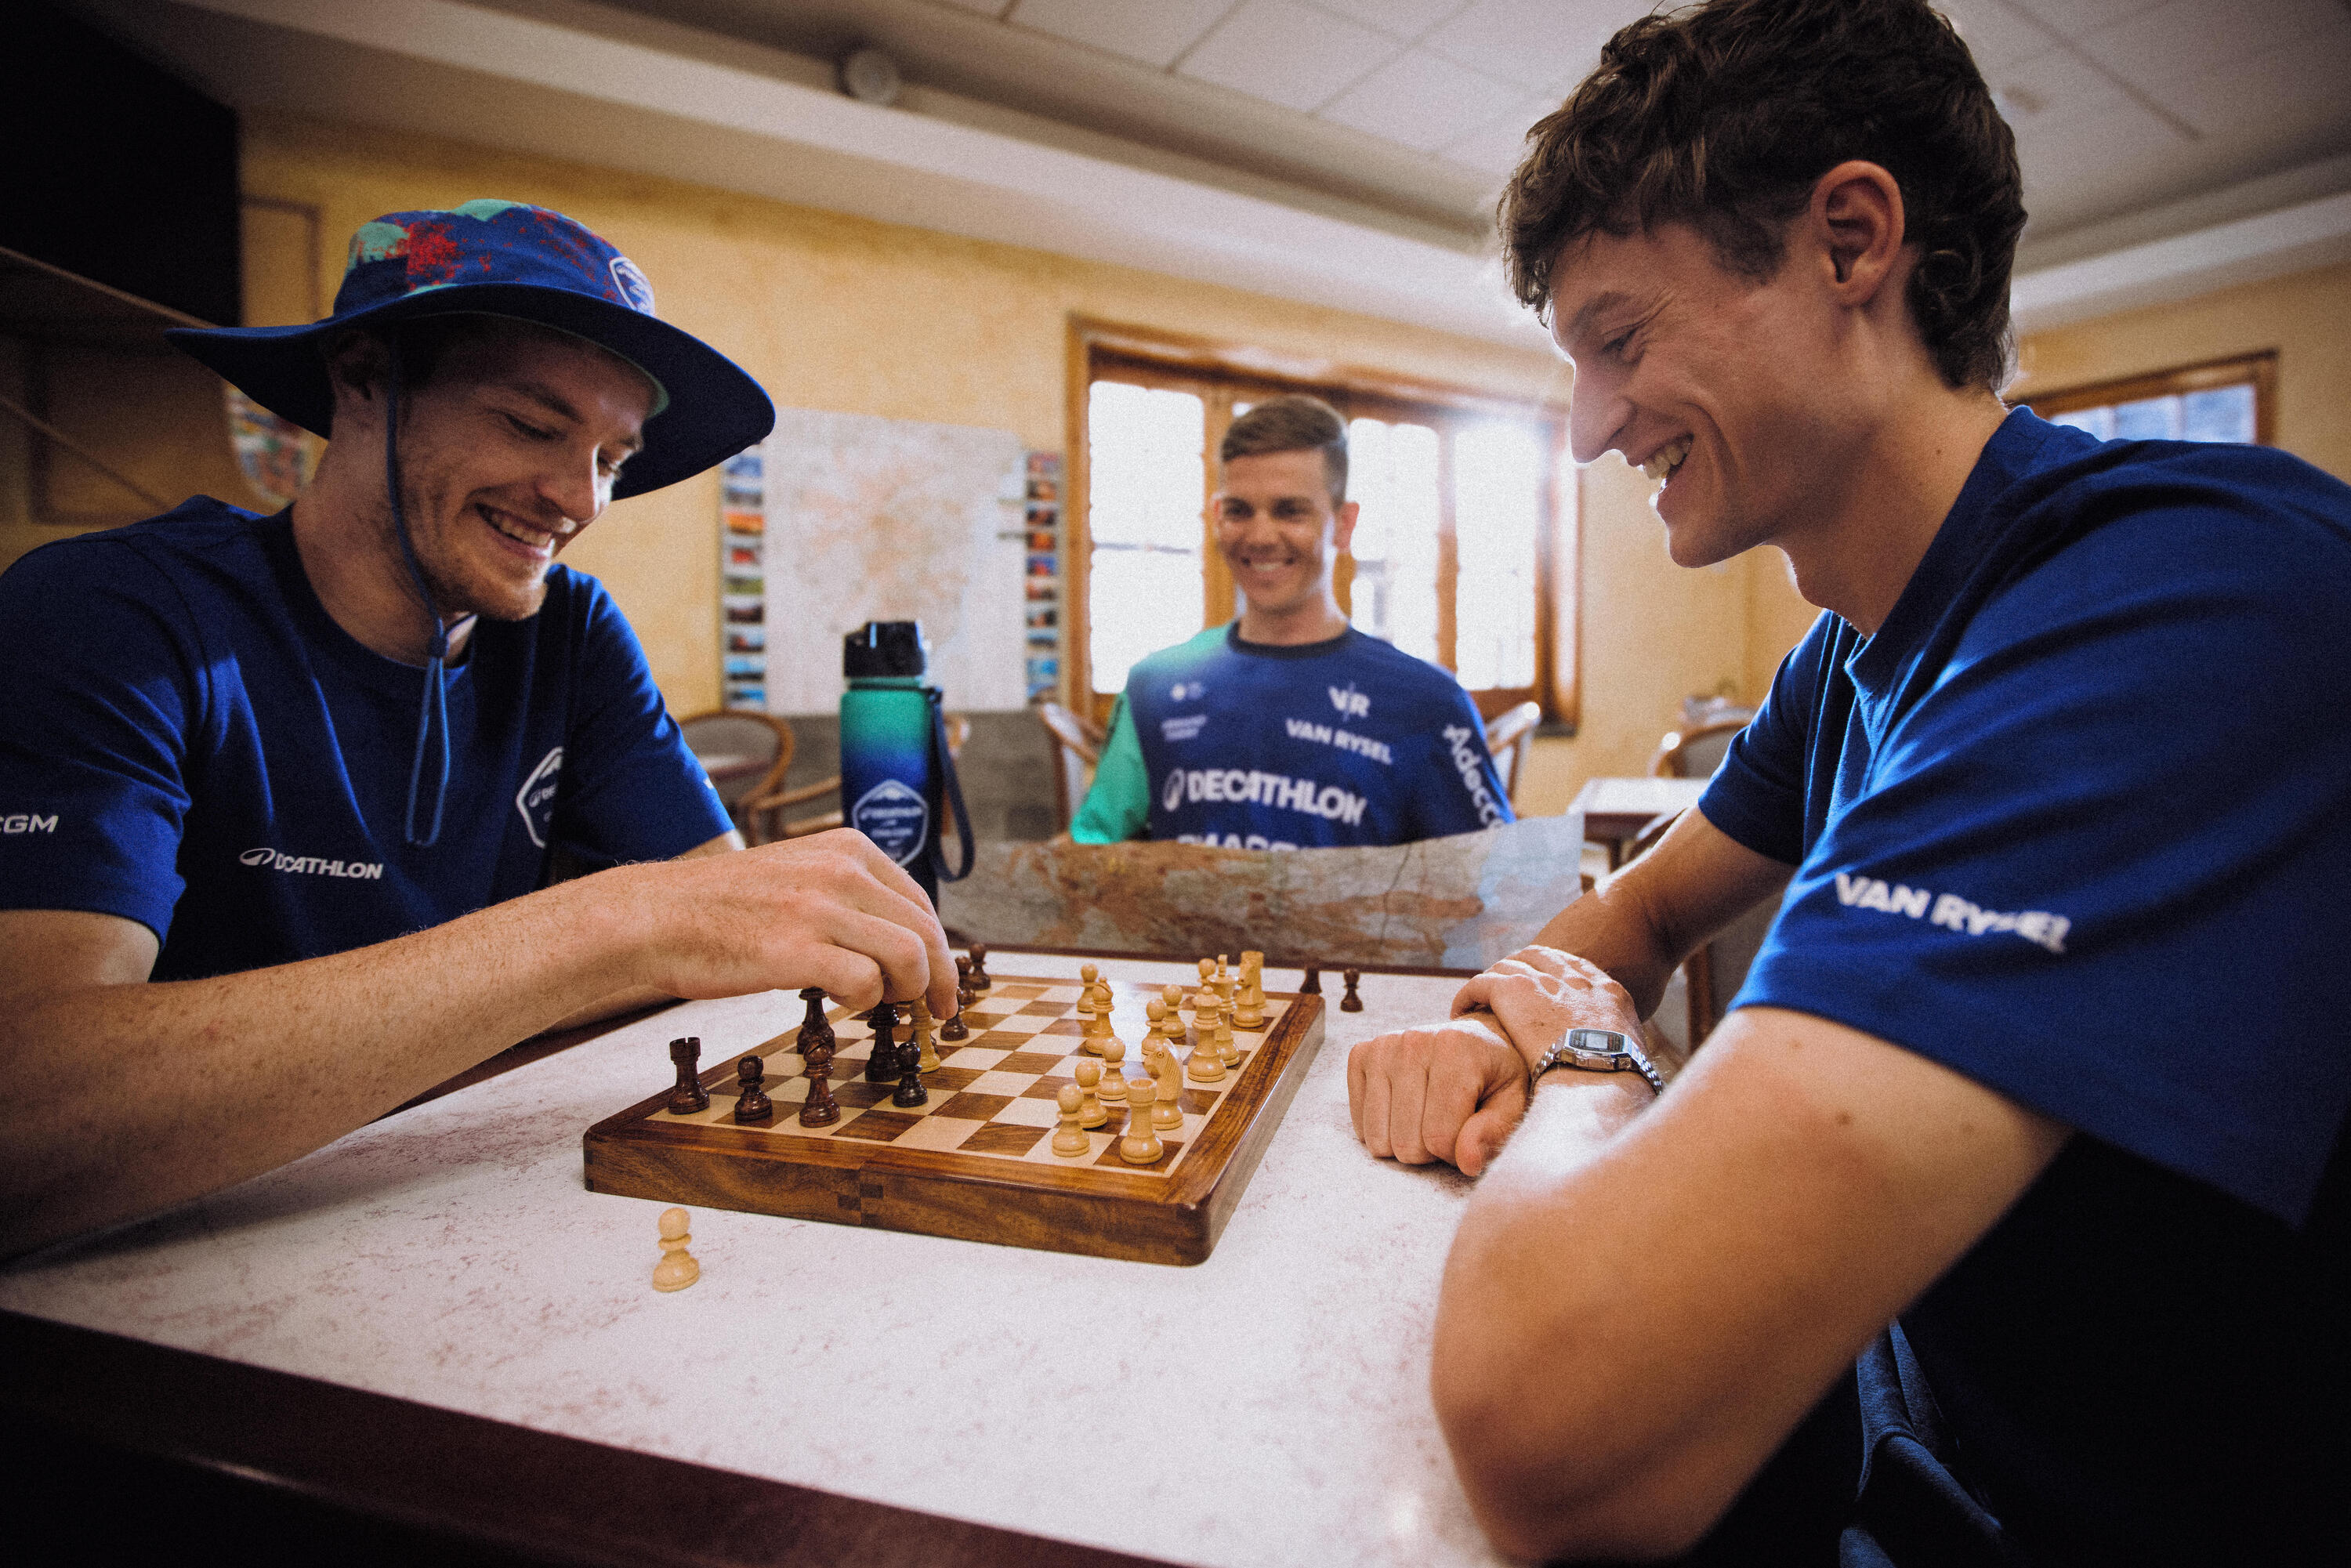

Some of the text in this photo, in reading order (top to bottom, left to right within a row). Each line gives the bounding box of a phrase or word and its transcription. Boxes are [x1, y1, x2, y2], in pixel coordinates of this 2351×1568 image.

[1286, 718, 1393, 766] VAN RYSEL
[1187, 768, 1367, 827] DECATHLON
[0, 814, 60, 833] GM
[1835, 871, 1932, 919] VAN
